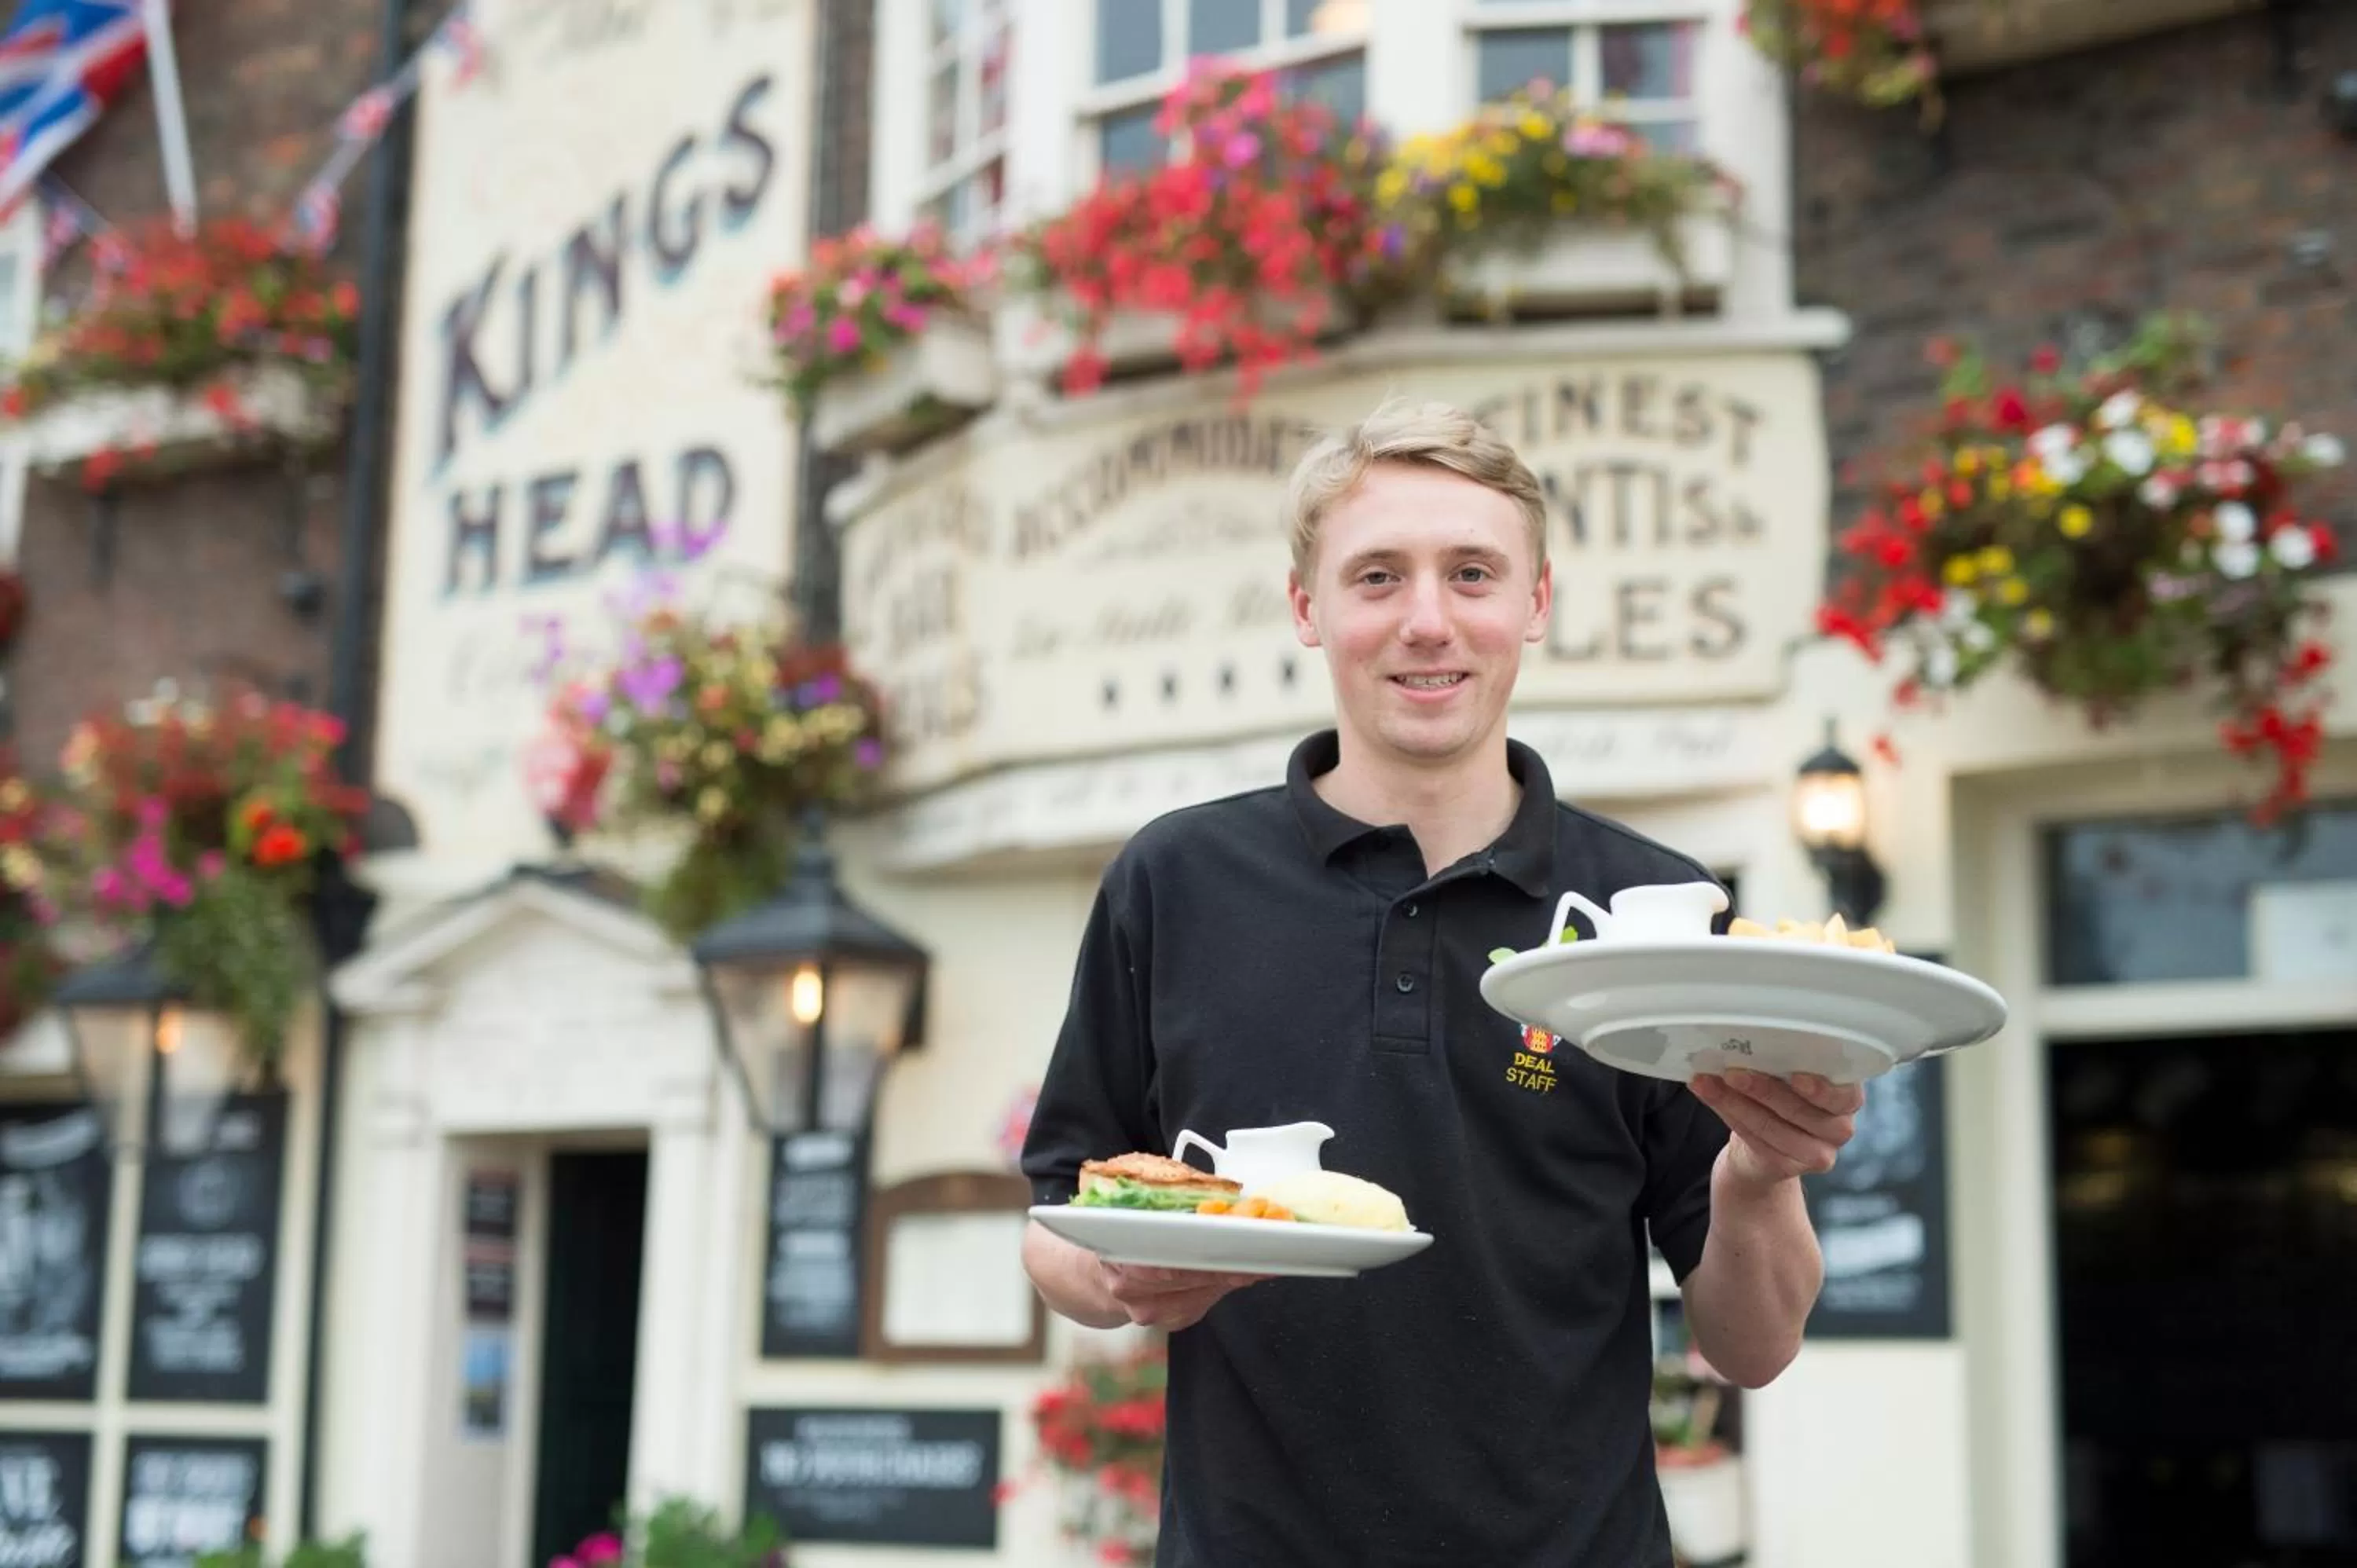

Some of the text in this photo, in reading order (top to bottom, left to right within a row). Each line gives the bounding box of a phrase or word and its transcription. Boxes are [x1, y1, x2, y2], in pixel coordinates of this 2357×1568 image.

[432, 73, 778, 479] KINGS
[442, 445, 737, 597] HEAD
[1546, 580, 1750, 662] LES
[1506, 1068, 1557, 1092] STAFF
[1515, 1053, 1554, 1073] DEAL
